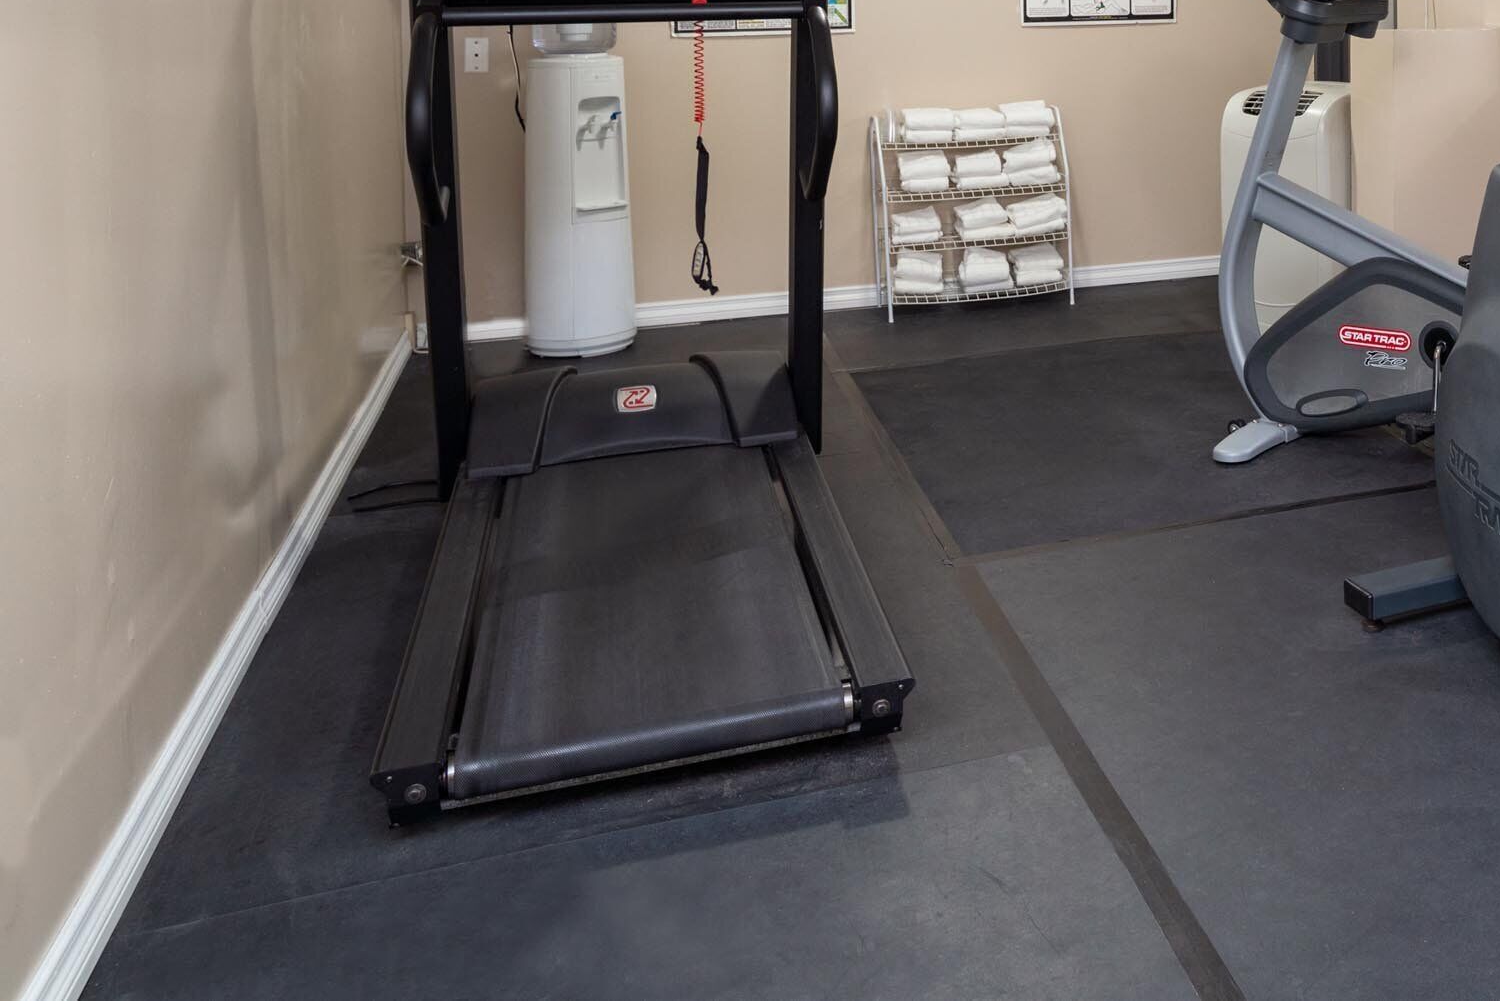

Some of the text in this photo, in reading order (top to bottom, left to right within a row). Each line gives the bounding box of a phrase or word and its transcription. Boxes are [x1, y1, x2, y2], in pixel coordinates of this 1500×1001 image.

[1342, 330, 1405, 346] STAR TRAC
[1364, 350, 1408, 369] Pro
